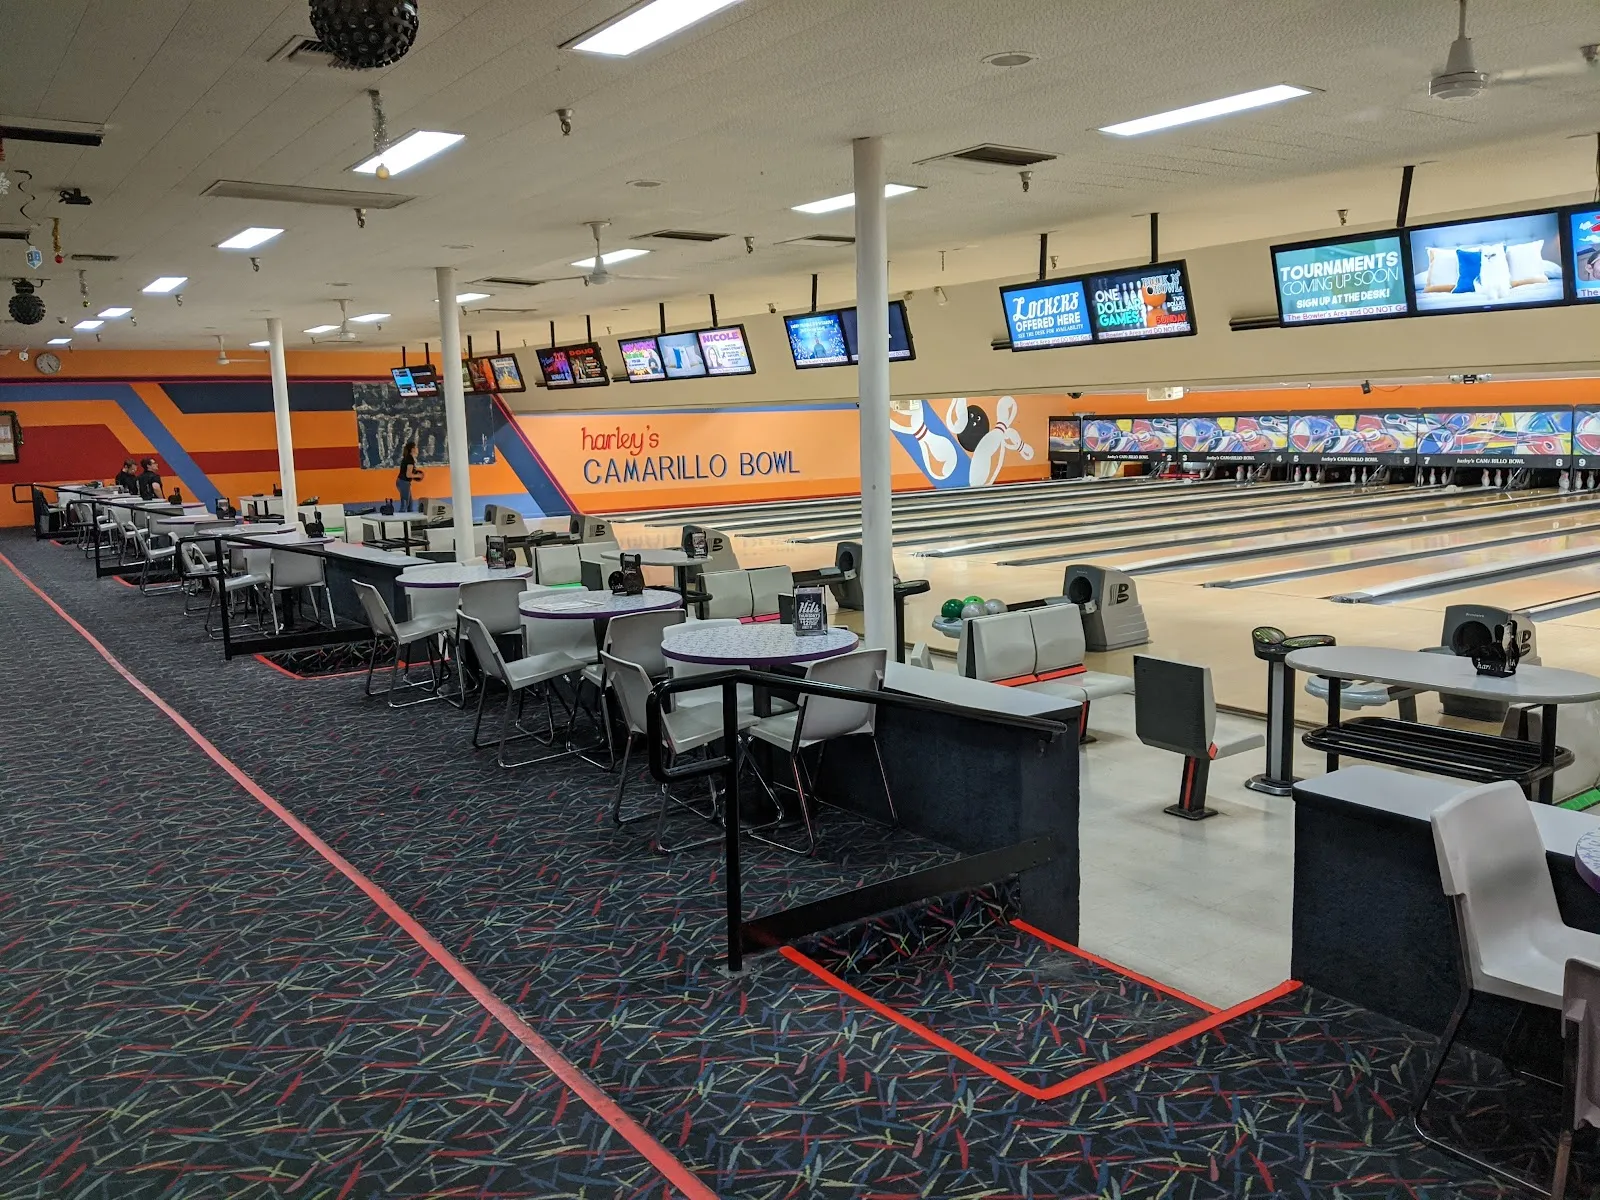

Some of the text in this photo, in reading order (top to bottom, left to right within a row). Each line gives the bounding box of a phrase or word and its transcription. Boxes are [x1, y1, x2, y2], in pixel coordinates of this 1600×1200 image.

[1280, 251, 1399, 282] TOURNAMENTS
[1282, 267, 1399, 296] COMING UP SOON
[1095, 288, 1120, 303] ONE
[1296, 288, 1390, 309] SIGN UP AT THE DESK!
[1581, 288, 1599, 297] The
[1097, 298, 1143, 315] DOLLAR
[1287, 313, 1301, 321] The
[1302, 311, 1332, 320] Bowler's
[1333, 309, 1348, 317] Area
[1350, 308, 1362, 316] and
[1363, 307, 1374, 315] DO
[1376, 305, 1393, 313] NOT
[1015, 312, 1081, 332] OFFERED HERE
[1156, 312, 1187, 325] SUNDAY
[702, 331, 740, 343] NICOLE
[581, 425, 660, 457] harley's
[1166, 454, 1173, 462] 2
[1182, 454, 1188, 462] 3
[1423, 457, 1431, 465] 7
[1555, 458, 1563, 467] 8
[1578, 458, 1586, 467] 9
[583, 450, 800, 484] CAMARILLO BOWL
